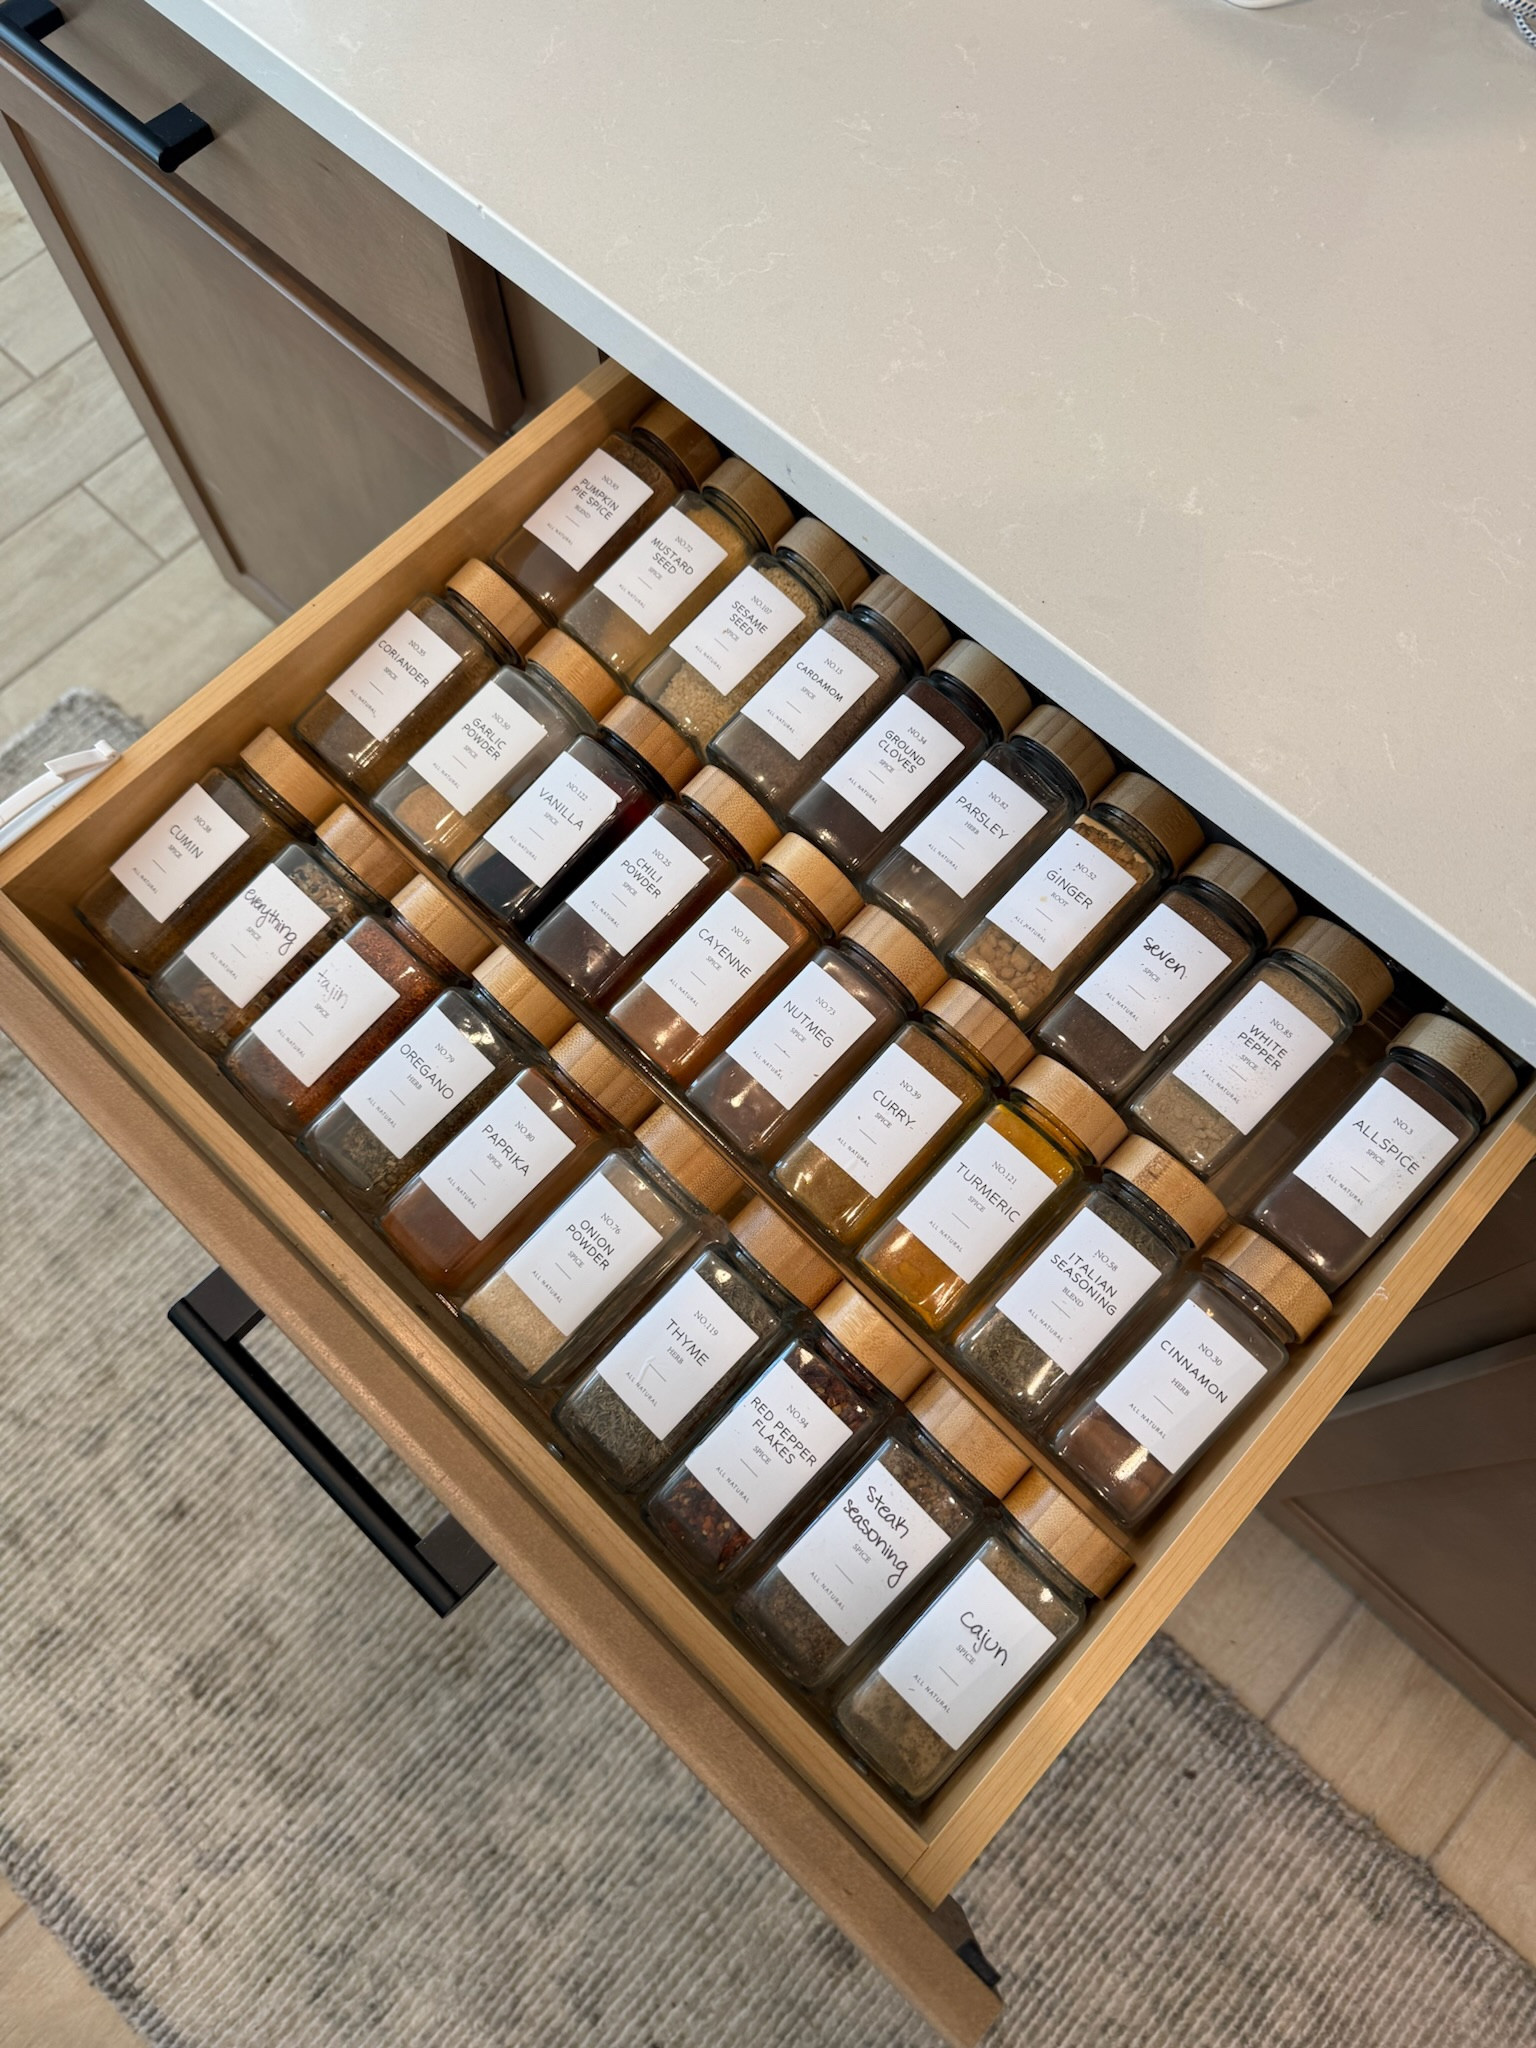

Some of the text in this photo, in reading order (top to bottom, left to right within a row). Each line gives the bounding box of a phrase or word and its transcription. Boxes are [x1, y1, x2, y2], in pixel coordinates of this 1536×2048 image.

[571, 485, 614, 521] PIE SPICE
[580, 478, 620, 516] PUMPKIN
[650, 537, 694, 576] MUSTARD
[674, 535, 694, 553] NO.72
[647, 566, 663, 581] SPICE
[652, 552, 677, 575] SEED
[731, 600, 769, 634] SESAME
[750, 595, 773, 615] NO.107
[722, 627, 740, 642] SPICE
[729, 613, 754, 636] SEED
[378, 639, 430, 688] CORIANDER
[823, 657, 844, 675] NO.15
[796, 662, 844, 703] CARDAMOM
[800, 686, 817, 700] SPICE
[461, 723, 501, 761] POWDER
[472, 718, 507, 750] GARLIC
[907, 726, 928, 745] NO.34
[878, 739, 917, 774] CLOVES
[885, 730, 926, 768] GROUND
[879, 758, 895, 774] SPICE
[566, 781, 589, 802] NO.122
[848, 777, 878, 804] ALL NATURAL
[539, 787, 584, 832] VANILLA
[543, 811, 559, 826] SPICE
[955, 795, 1009, 840] PARSLEY
[169, 824, 204, 859] CUMIN
[963, 820, 980, 835] HERB
[636, 857, 663, 883] CHILI
[651, 848, 672, 868] NO.25
[928, 843, 959, 871] ALL NATURAL
[1075, 861, 1097, 881] NO.52
[620, 859, 662, 899] POWDER
[622, 881, 638, 897] SPICE
[1046, 870, 1093, 910] GINGER
[1050, 891, 1069, 907] ROOT
[244, 888, 298, 957] everything
[591, 900, 620, 928] ALL NATURAL
[245, 926, 262, 942] SPICE
[730, 925, 751, 945] NO.16
[1014, 915, 1046, 943] ALL NATURAL
[698, 928, 752, 979] CAYENNE
[705, 955, 722, 971] SPICE
[1142, 967, 1161, 983] SPICE
[669, 978, 699, 1007] ALL NATURAL
[815, 996, 837, 1016] NO.73
[313, 1003, 330, 1019] SPICE
[1105, 992, 1138, 1022] ALL NATURAL
[783, 1000, 835, 1049] NUTMEG
[790, 1027, 807, 1043] SPICE
[1269, 1017, 1294, 1039] NO.85
[434, 1042, 455, 1064] NO.79
[1237, 1031, 1282, 1071] PEPPER
[1249, 1024, 1288, 1059] WHITE
[399, 1043, 455, 1100] OREGANO
[752, 1050, 783, 1080] ALL NATURAL
[1239, 1054, 1259, 1071] SPICE
[406, 1073, 423, 1090] HERB
[899, 1079, 922, 1100] NO.39
[1205, 1073, 1240, 1104] ALL NATURAL
[367, 1097, 397, 1128] ALL NATURAL
[872, 1089, 916, 1127] CURRY
[874, 1112, 893, 1129] SPICE
[514, 1120, 536, 1143] NO.80
[1392, 1116, 1414, 1135] NO.3
[481, 1124, 530, 1177] PAPRIKA
[486, 1152, 503, 1170] SPICE
[837, 1137, 870, 1168] ALL NATURAL
[1352, 1119, 1420, 1175] ALLSPICE
[1365, 1148, 1386, 1166] SPICE
[991, 1160, 1017, 1185] NO.121
[447, 1176, 477, 1209] ALL NATURAL
[956, 1161, 1021, 1223] TURMERIC
[967, 1195, 986, 1213] SPICE
[1327, 1174, 1364, 1206] ALL NATURAL
[580, 1219, 615, 1256] ONION
[600, 1212, 621, 1235] NO.76
[929, 1220, 963, 1253] ALL NATURAL
[565, 1223, 610, 1271] POWDER
[567, 1250, 585, 1269] SPICE
[1094, 1249, 1119, 1272] NO.58
[531, 1270, 563, 1304] ALL NATURAL
[1050, 1254, 1117, 1316] SEASONING
[1068, 1252, 1118, 1298] ITALIAN
[1062, 1286, 1084, 1308] BLEND
[693, 1310, 719, 1336] NO.119
[1027, 1308, 1064, 1343] ALL NATURAL
[666, 1318, 710, 1367] THYME
[666, 1346, 684, 1365] HERB
[1197, 1342, 1223, 1367] NO.30
[1160, 1339, 1229, 1404] CINNAMON
[625, 1371, 658, 1407] ALL NATURAL
[1170, 1377, 1191, 1397] HERB
[786, 1404, 809, 1429] NO.94
[1129, 1403, 1166, 1439] ALL NATURAL
[750, 1396, 817, 1467] RED PEPPER
[751, 1418, 796, 1465] FLAKES
[752, 1445, 772, 1465] SPICE
[715, 1466, 750, 1504] ALL NATURAL
[842, 1498, 909, 1589] seasoning
[852, 1543, 872, 1564] SPICE
[810, 1571, 845, 1611] ALL NATURAL
[955, 1644, 976, 1665] SPICE
[913, 1674, 951, 1713] ALL NATURAL
